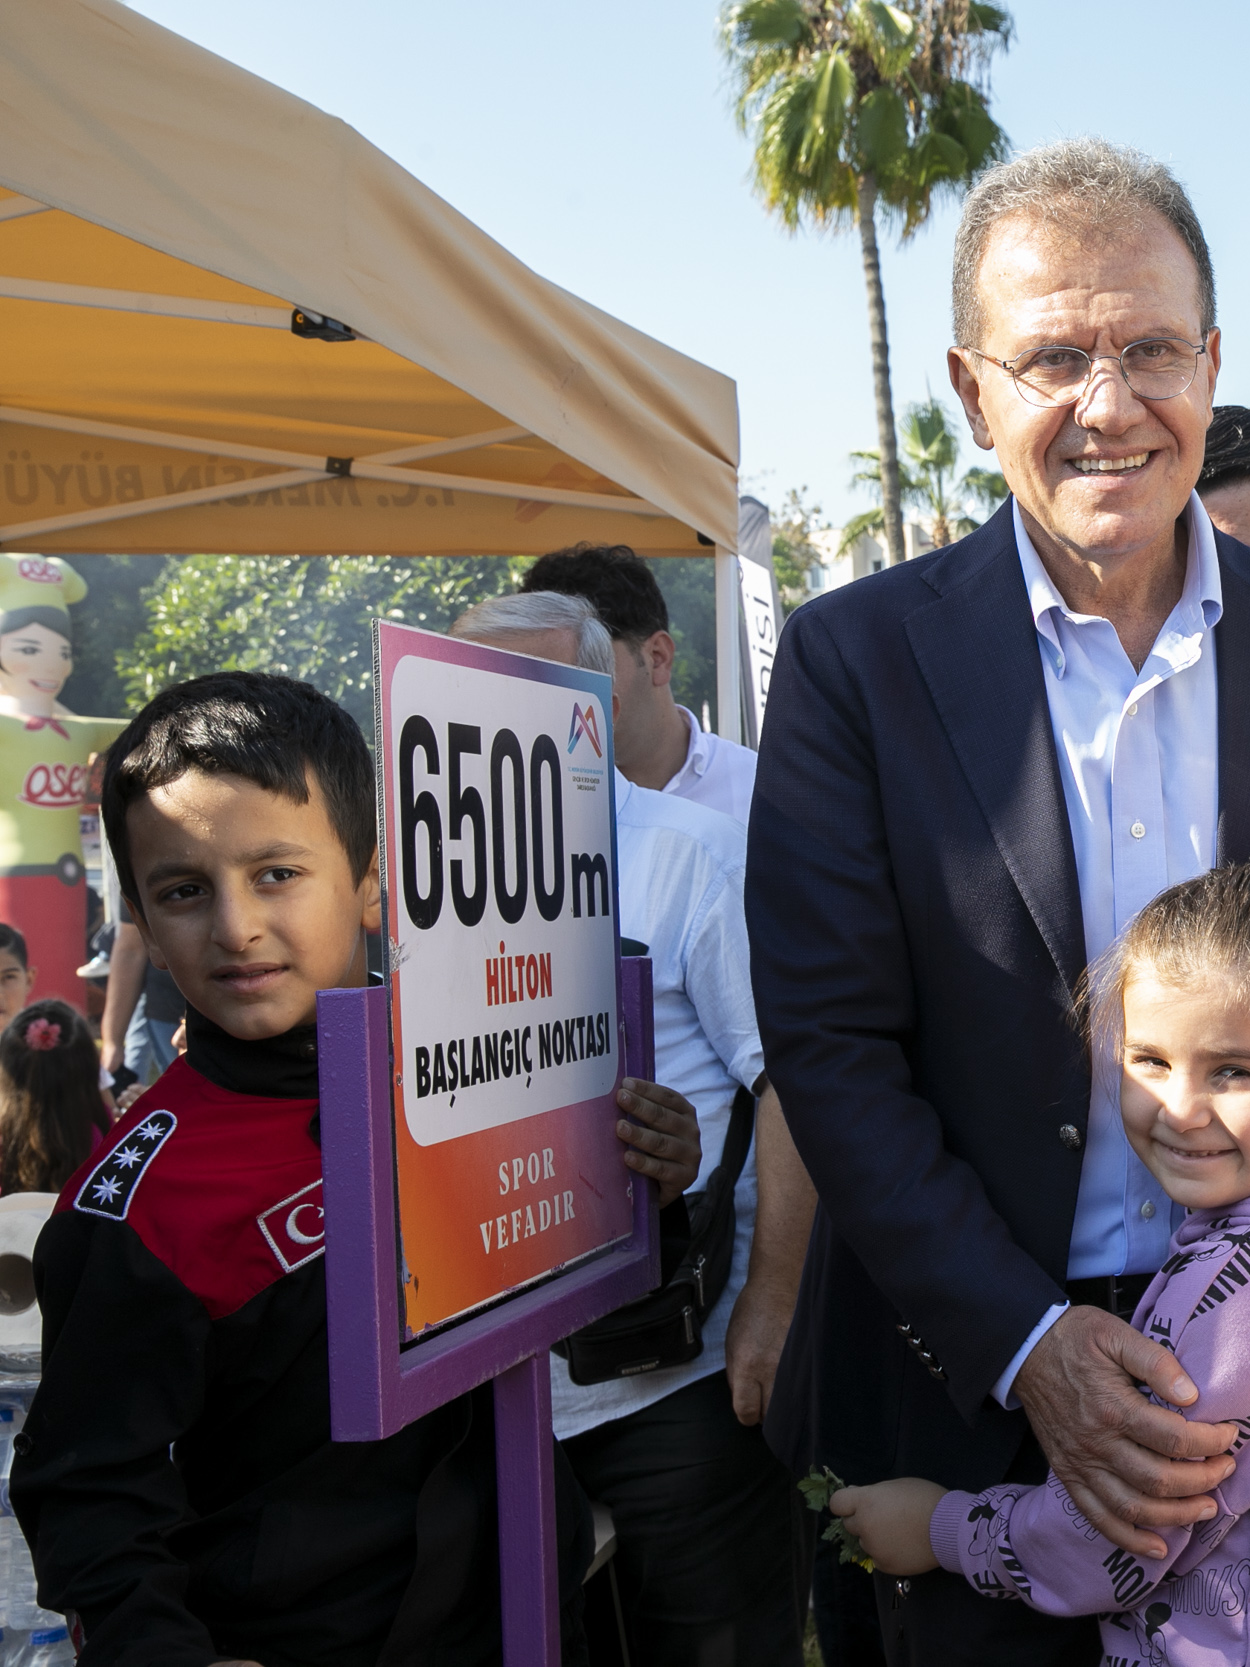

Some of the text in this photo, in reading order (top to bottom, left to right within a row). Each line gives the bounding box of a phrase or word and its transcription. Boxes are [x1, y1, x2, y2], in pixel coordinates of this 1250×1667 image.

[485, 940, 553, 1007] HİLTON
[415, 1012, 611, 1109] BAŞLANGIÇ NOKTASI
[498, 1147, 556, 1196] SPOR
[479, 1190, 576, 1255] VEFADIR
